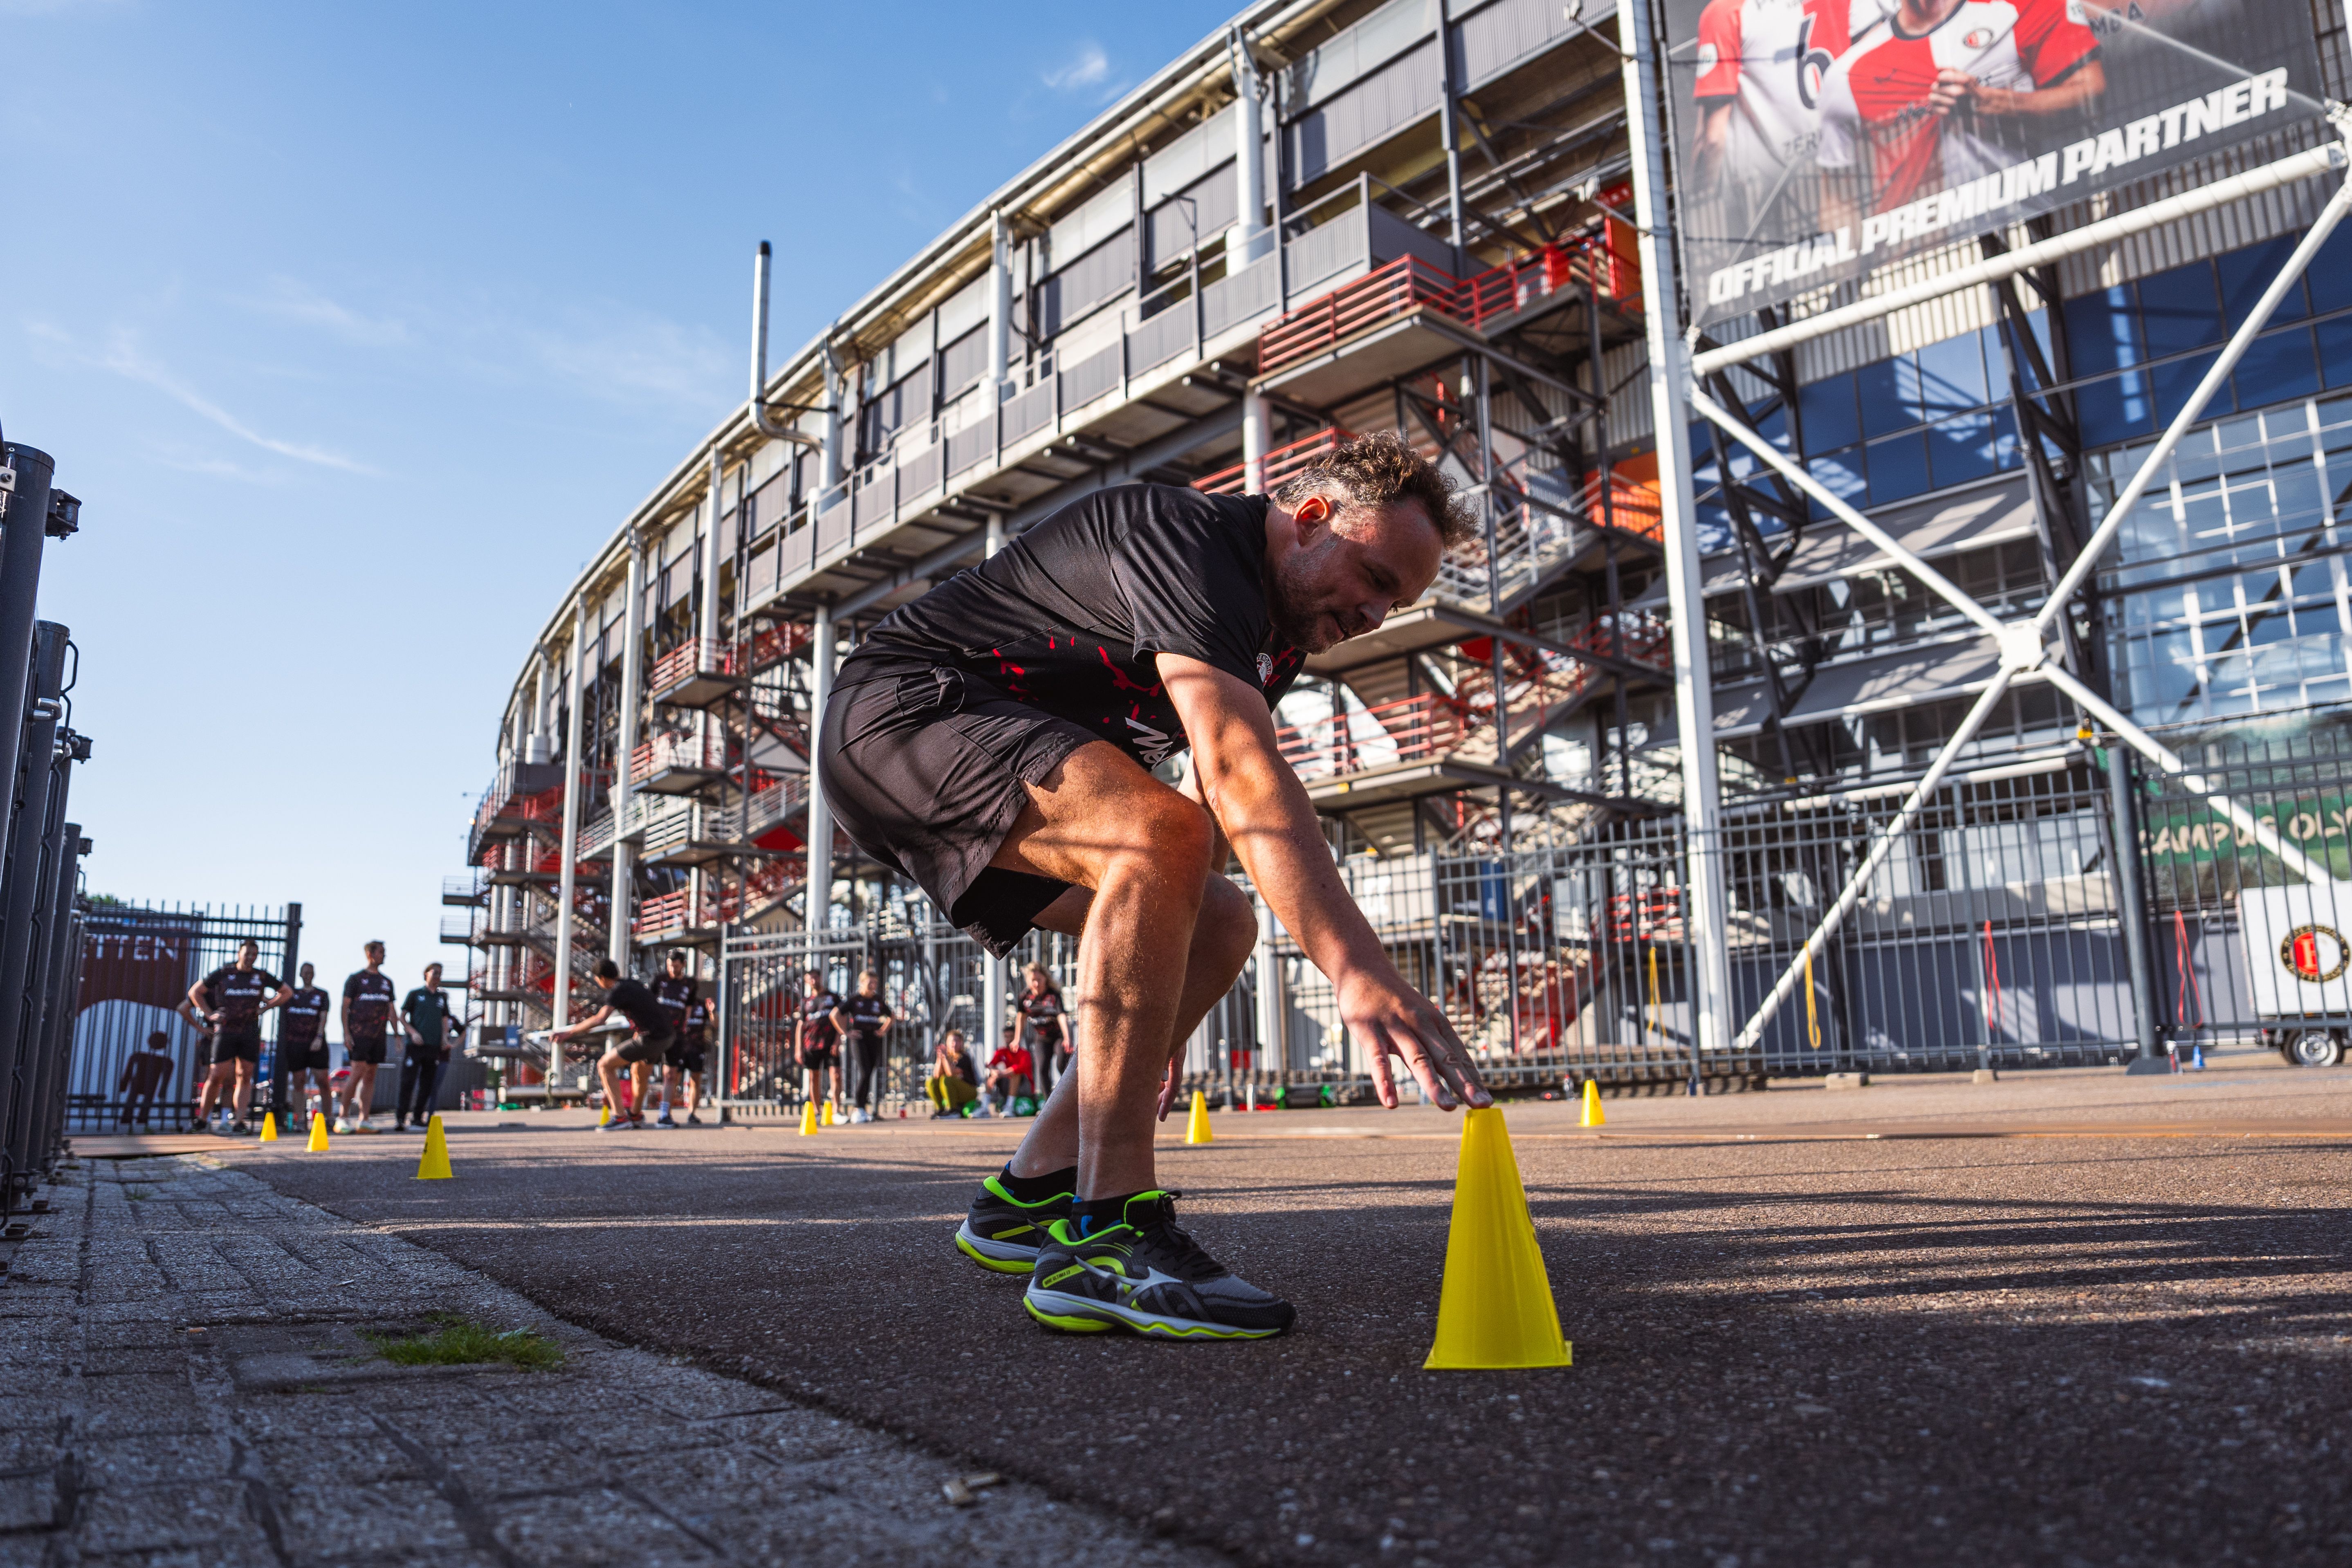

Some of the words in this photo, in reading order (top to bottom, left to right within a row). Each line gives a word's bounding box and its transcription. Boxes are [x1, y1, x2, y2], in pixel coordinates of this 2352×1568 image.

[1708, 226, 1858, 306] OFFICIAL
[1860, 150, 2058, 255] PREMIUM
[2061, 66, 2288, 186] PARTNER
